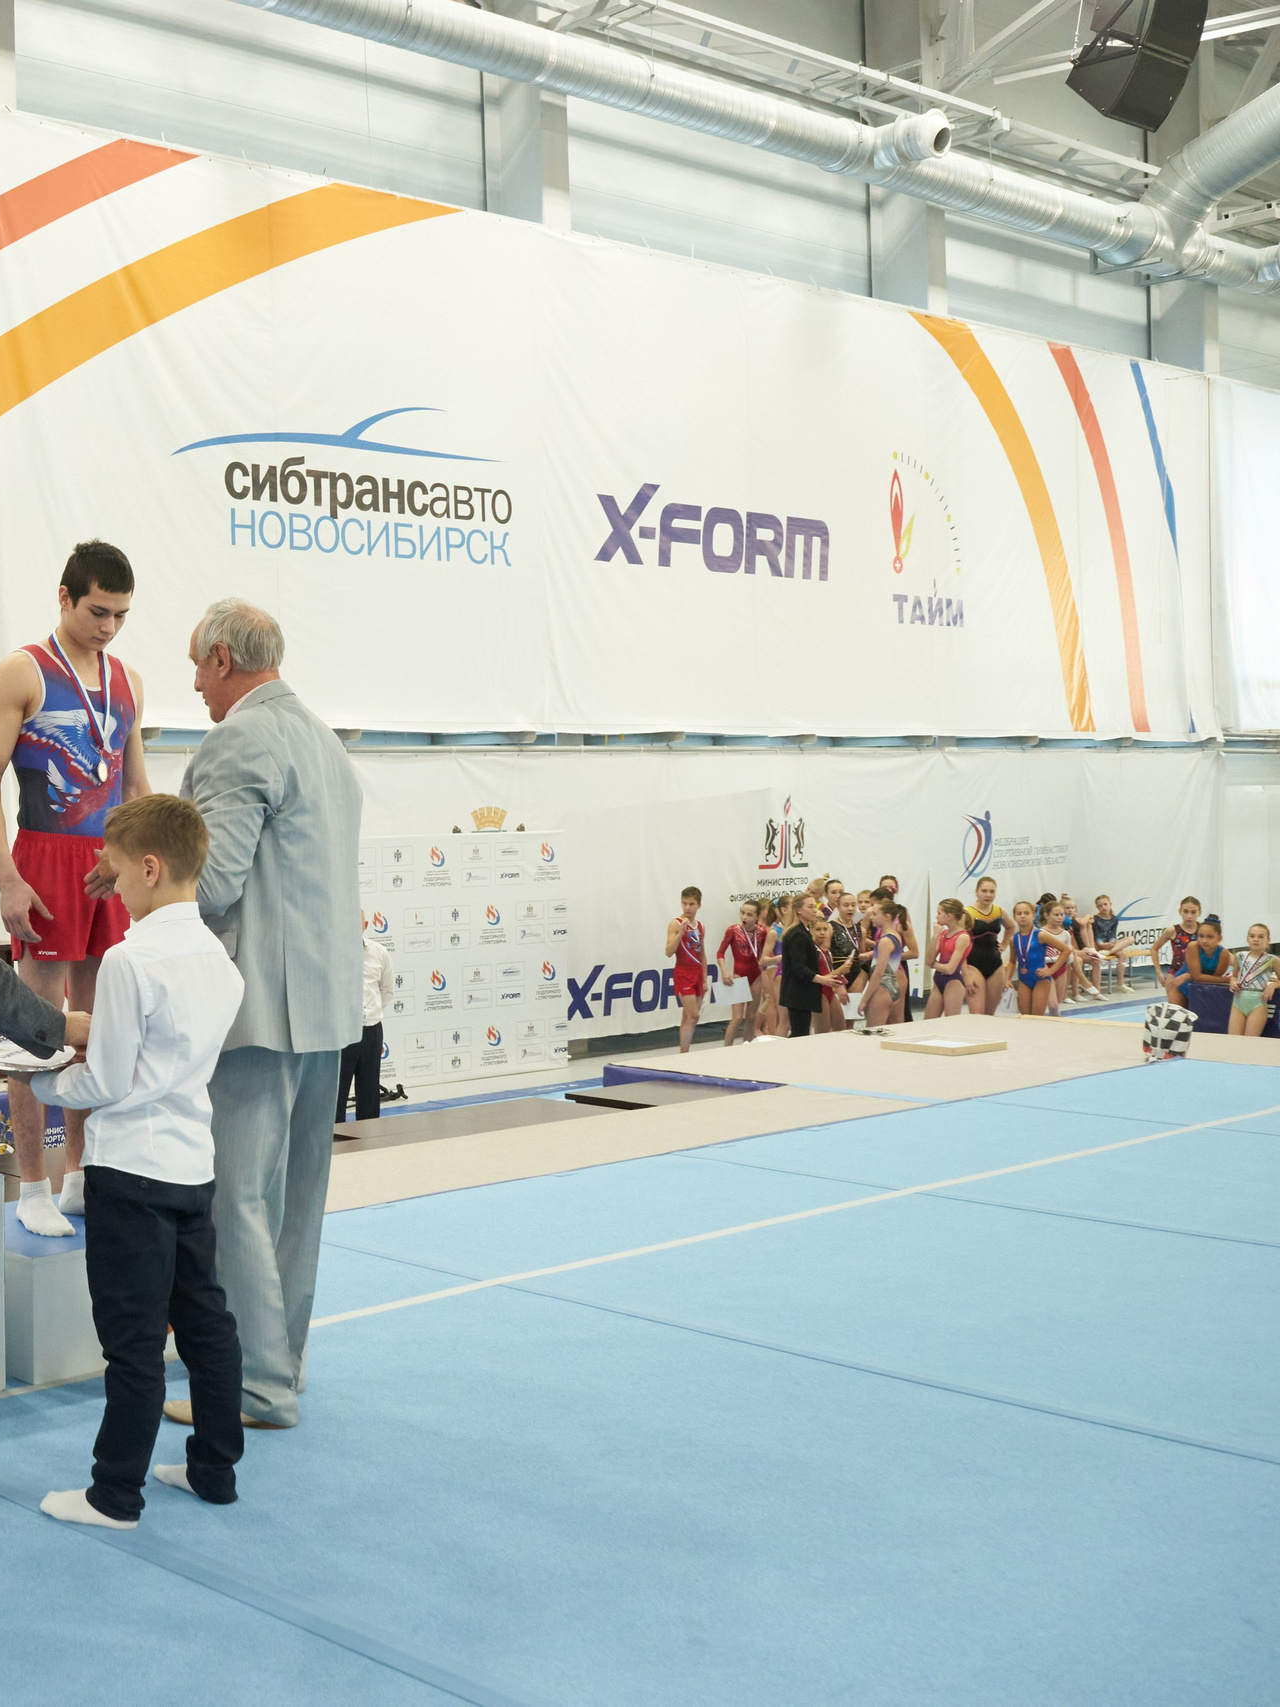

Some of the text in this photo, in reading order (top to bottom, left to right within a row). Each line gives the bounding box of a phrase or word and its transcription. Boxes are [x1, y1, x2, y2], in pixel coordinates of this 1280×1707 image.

[224, 456, 512, 525] сибтрансавто
[230, 507, 512, 567] НОВОСИБИРСК
[593, 482, 830, 582] X-FORM
[756, 876, 809, 887] МИНИСТЕРСТВО
